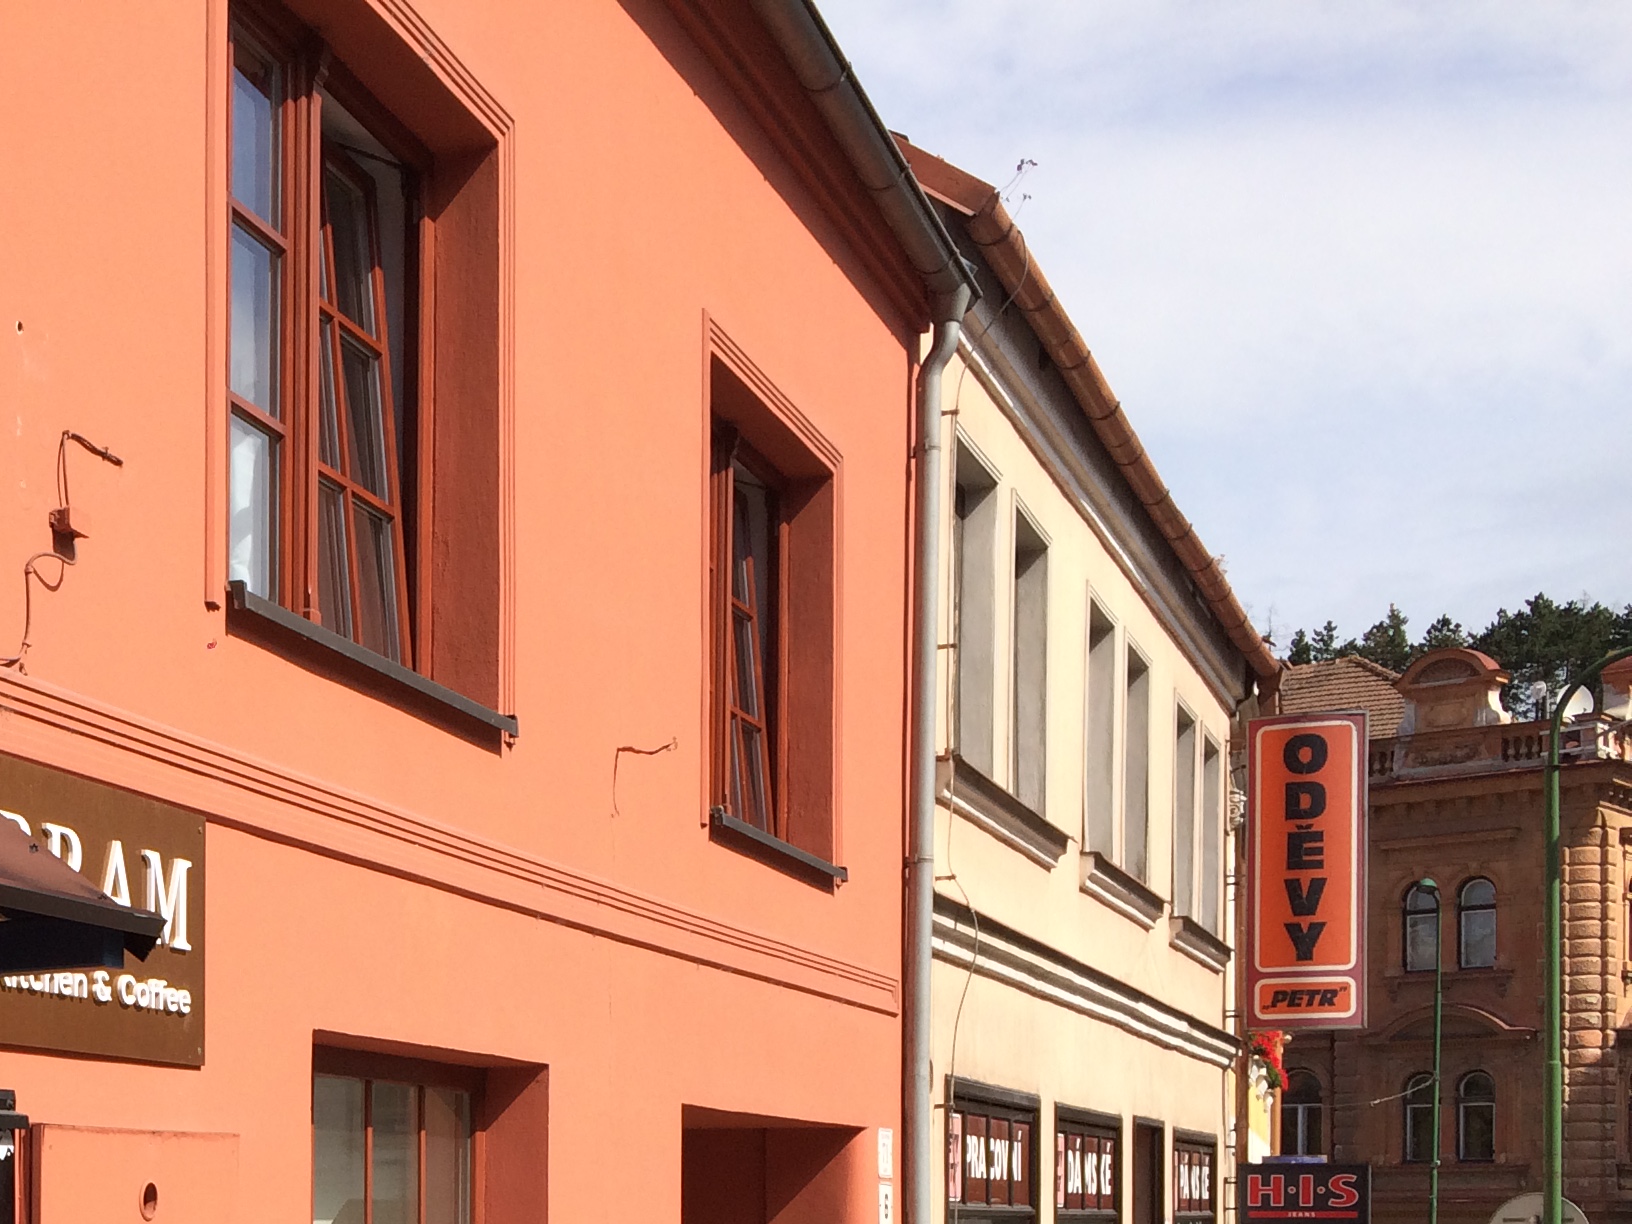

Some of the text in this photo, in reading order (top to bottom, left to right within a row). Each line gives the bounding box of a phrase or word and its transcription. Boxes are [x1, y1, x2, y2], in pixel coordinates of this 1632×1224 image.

[1283, 733, 1328, 962] ODĚVY
[92, 970, 113, 1002] &
[119, 974, 192, 1014] Coffee
[1287, 1211, 1317, 1219] JEANS
